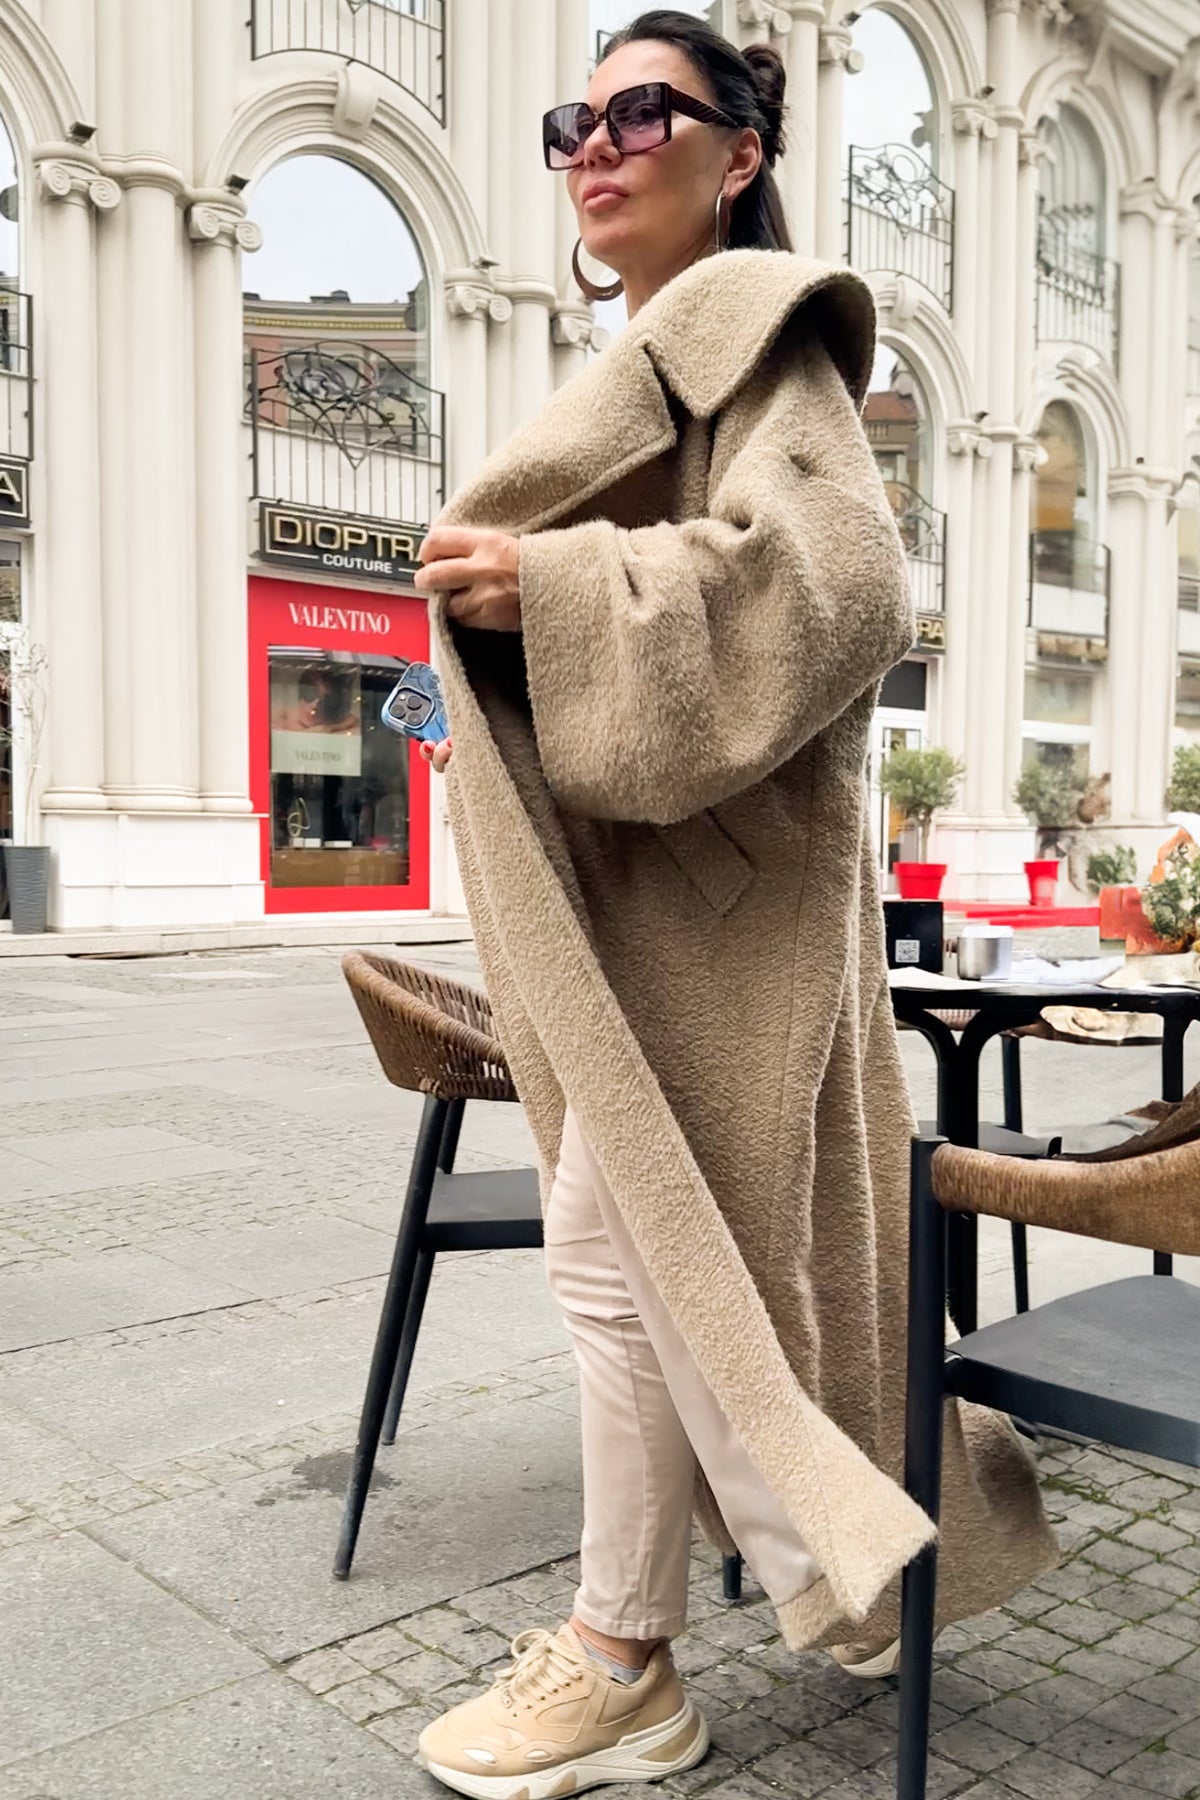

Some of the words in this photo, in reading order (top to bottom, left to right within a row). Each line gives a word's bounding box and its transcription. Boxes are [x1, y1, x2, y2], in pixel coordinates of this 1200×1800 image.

[273, 515, 421, 562] DIOPTR
[323, 553, 393, 574] COUTURE
[288, 602, 391, 635] VALENTINO
